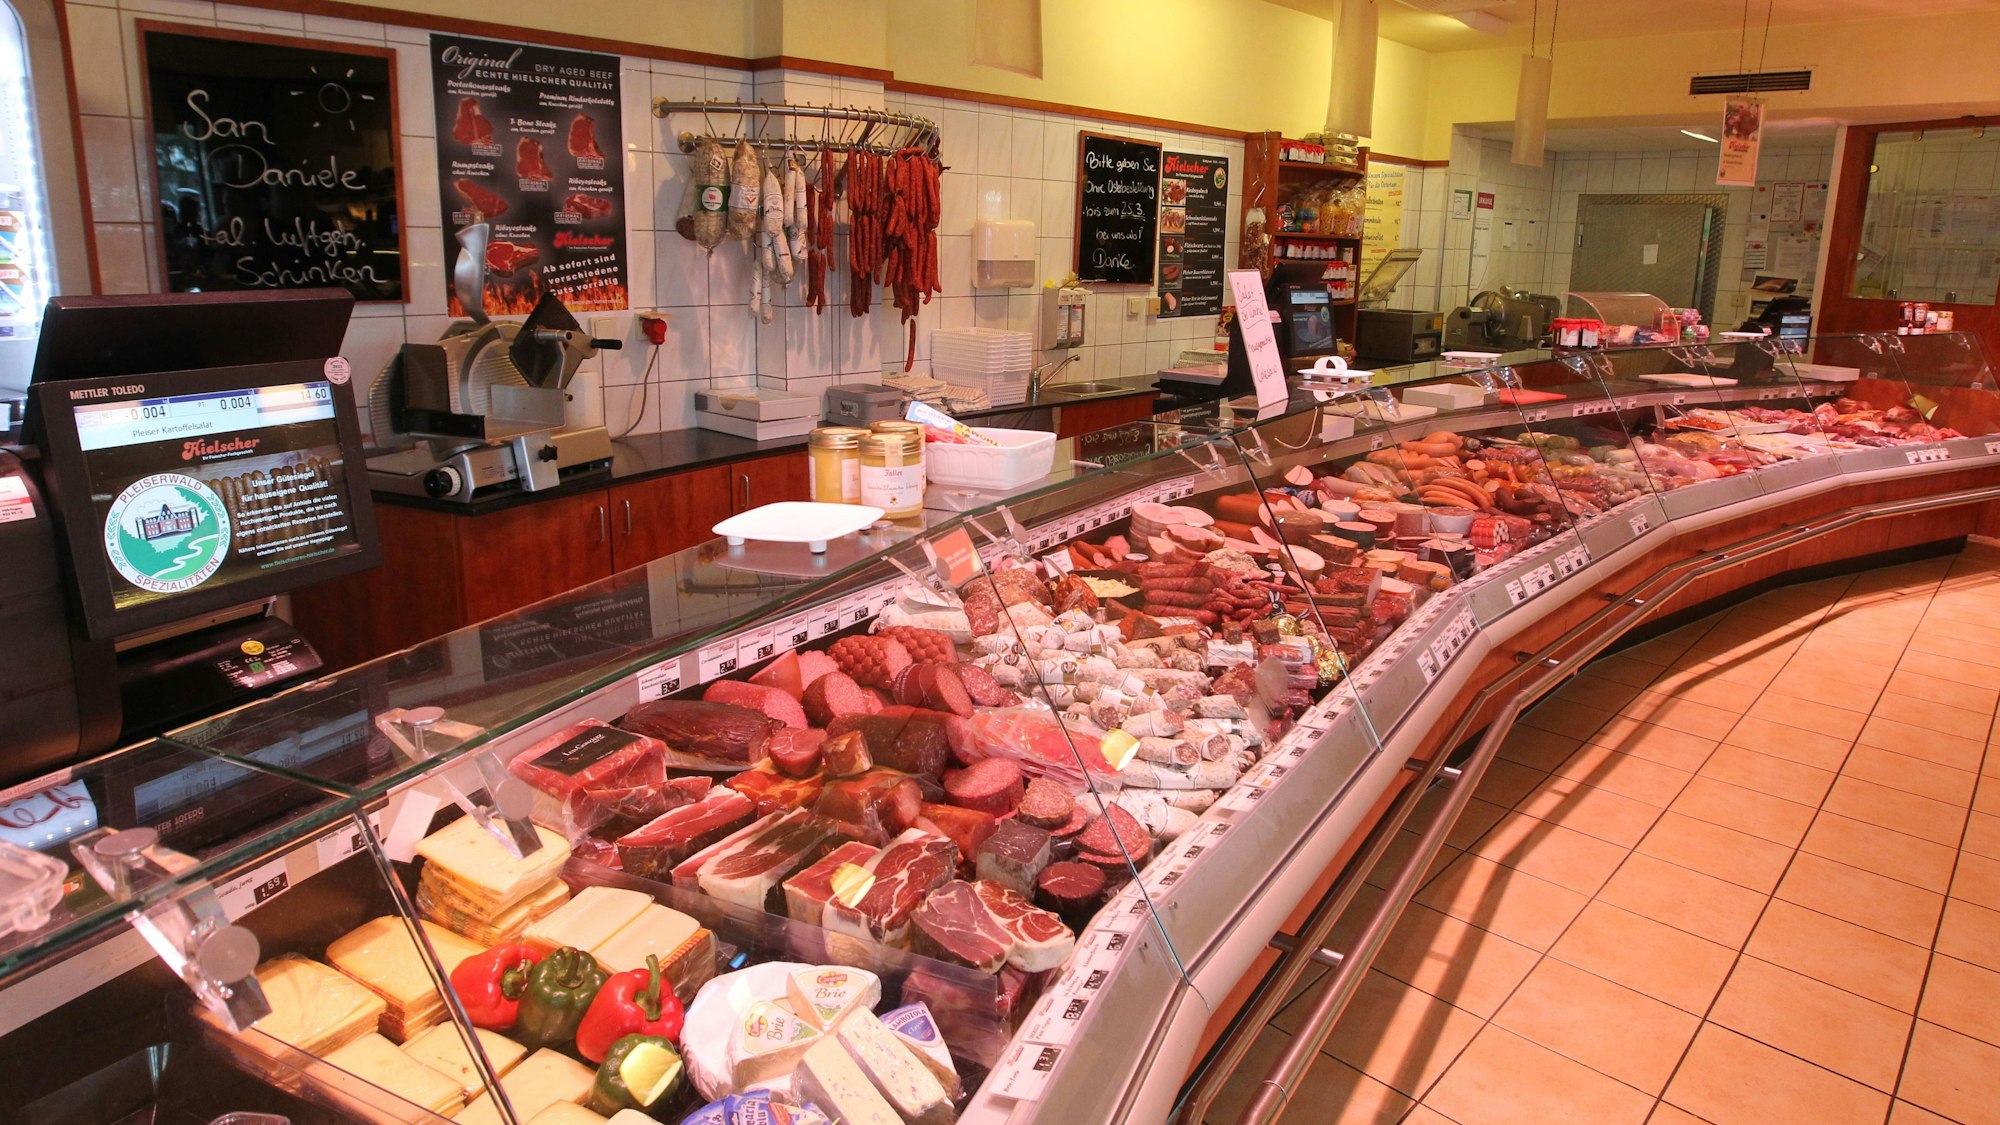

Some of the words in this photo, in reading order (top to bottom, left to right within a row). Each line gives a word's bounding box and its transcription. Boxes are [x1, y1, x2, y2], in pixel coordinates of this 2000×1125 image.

[441, 45, 523, 80] Original
[535, 64, 556, 72] DRY
[559, 66, 586, 76] AGED
[590, 70, 613, 80] BEEF
[475, 70, 510, 80] ECHTE
[512, 74, 567, 85] HIELSCHER
[568, 78, 614, 90] QUALITÄT
[184, 89, 276, 145] San
[208, 144, 366, 188] Daniele
[1086, 151, 1114, 169] Bitte
[1116, 158, 1140, 172] geben
[1143, 158, 1157, 172] Sie
[1165, 156, 1209, 173] Hielscher
[1086, 204, 1102, 217] bis
[1104, 208, 1120, 216] zum
[554, 232, 614, 248] Hielscher
[1096, 227, 1109, 239] bei
[1111, 231, 1125, 240] uns
[543, 264, 556, 274] Ab
[559, 258, 592, 271] sofort
[594, 253, 616, 264] sind
[1092, 248, 1135, 268] Danke
[236, 256, 388, 286] Schinken
[548, 266, 619, 284] verschiedene
[576, 278, 619, 292] vorrätig
[70, 388, 108, 400] METTLER
[112, 384, 145, 396] TOLEDO
[300, 388, 327, 402] 14.60
[220, 396, 251, 410] 0.004
[132, 427, 160, 438] Pleiser
[161, 420, 213, 434] Kartoffelsalat
[182, 436, 260, 460] Hielscher
[252, 478, 274, 487] Unser
[276, 470, 315, 485] Gütesiegel
[119, 474, 203, 504] PLEISERWALD
[242, 494, 253, 502] für
[254, 486, 296, 501] hauseigene
[299, 480, 328, 492] Qualität!
[240, 514, 278, 527] hochwertigen
[280, 508, 305, 520] Produkte,
[325, 502, 338, 511] nach
[246, 506, 272, 516] erkennen
[283, 502, 293, 510] auf
[293, 498, 312, 508] Anhieb
[322, 494, 338, 503] vielen
[236, 528, 255, 538] eigens
[256, 521, 291, 534] entwickelten
[292, 516, 316, 528] Rezepten
[318, 511, 344, 522] herstellen.
[134, 557, 220, 591] SPEZIALITÄTEN
[262, 876, 281, 897] 1.69
[814, 987, 846, 998] Brie
[766, 1017, 785, 1041] Brie
